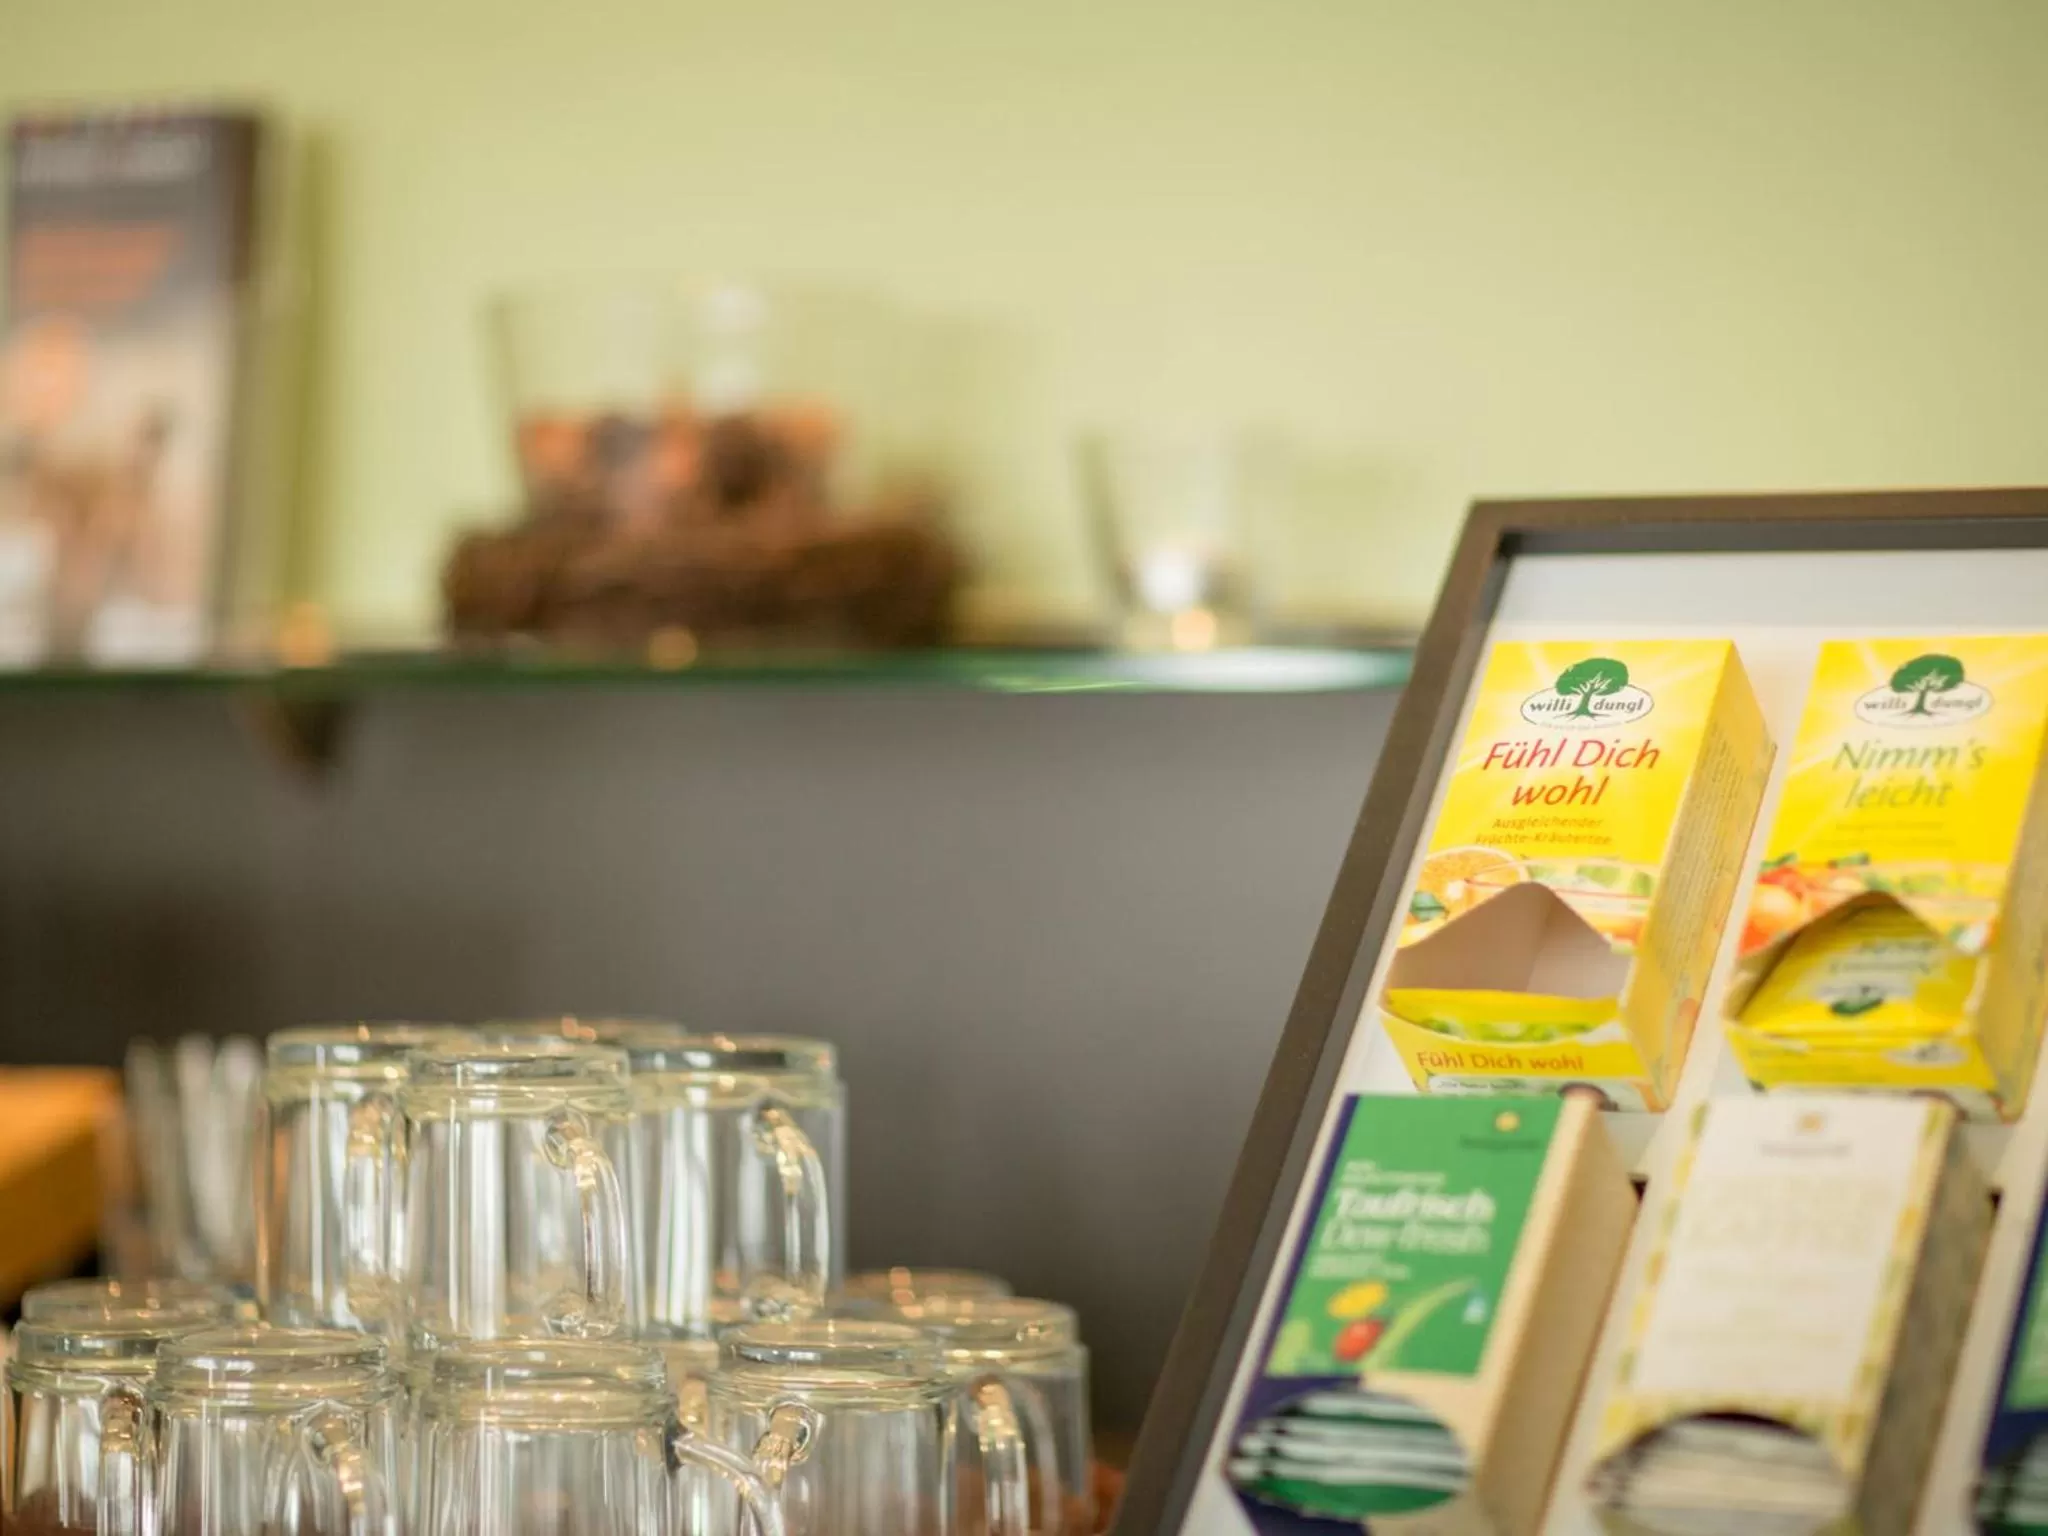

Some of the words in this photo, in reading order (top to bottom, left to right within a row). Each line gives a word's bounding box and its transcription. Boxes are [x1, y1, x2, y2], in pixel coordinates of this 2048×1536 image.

[1530, 698, 1573, 712] willi
[1593, 697, 1645, 713] dungl
[1483, 738, 1567, 770] Fühl
[1572, 739, 1661, 769] Dich
[1832, 738, 1988, 771] Nimm's
[1511, 776, 1610, 806] wohl
[1844, 775, 1953, 809] leicht
[1417, 1051, 1465, 1069] Fühl
[1470, 1053, 1523, 1069] Dich
[1529, 1054, 1585, 1072] wohl
